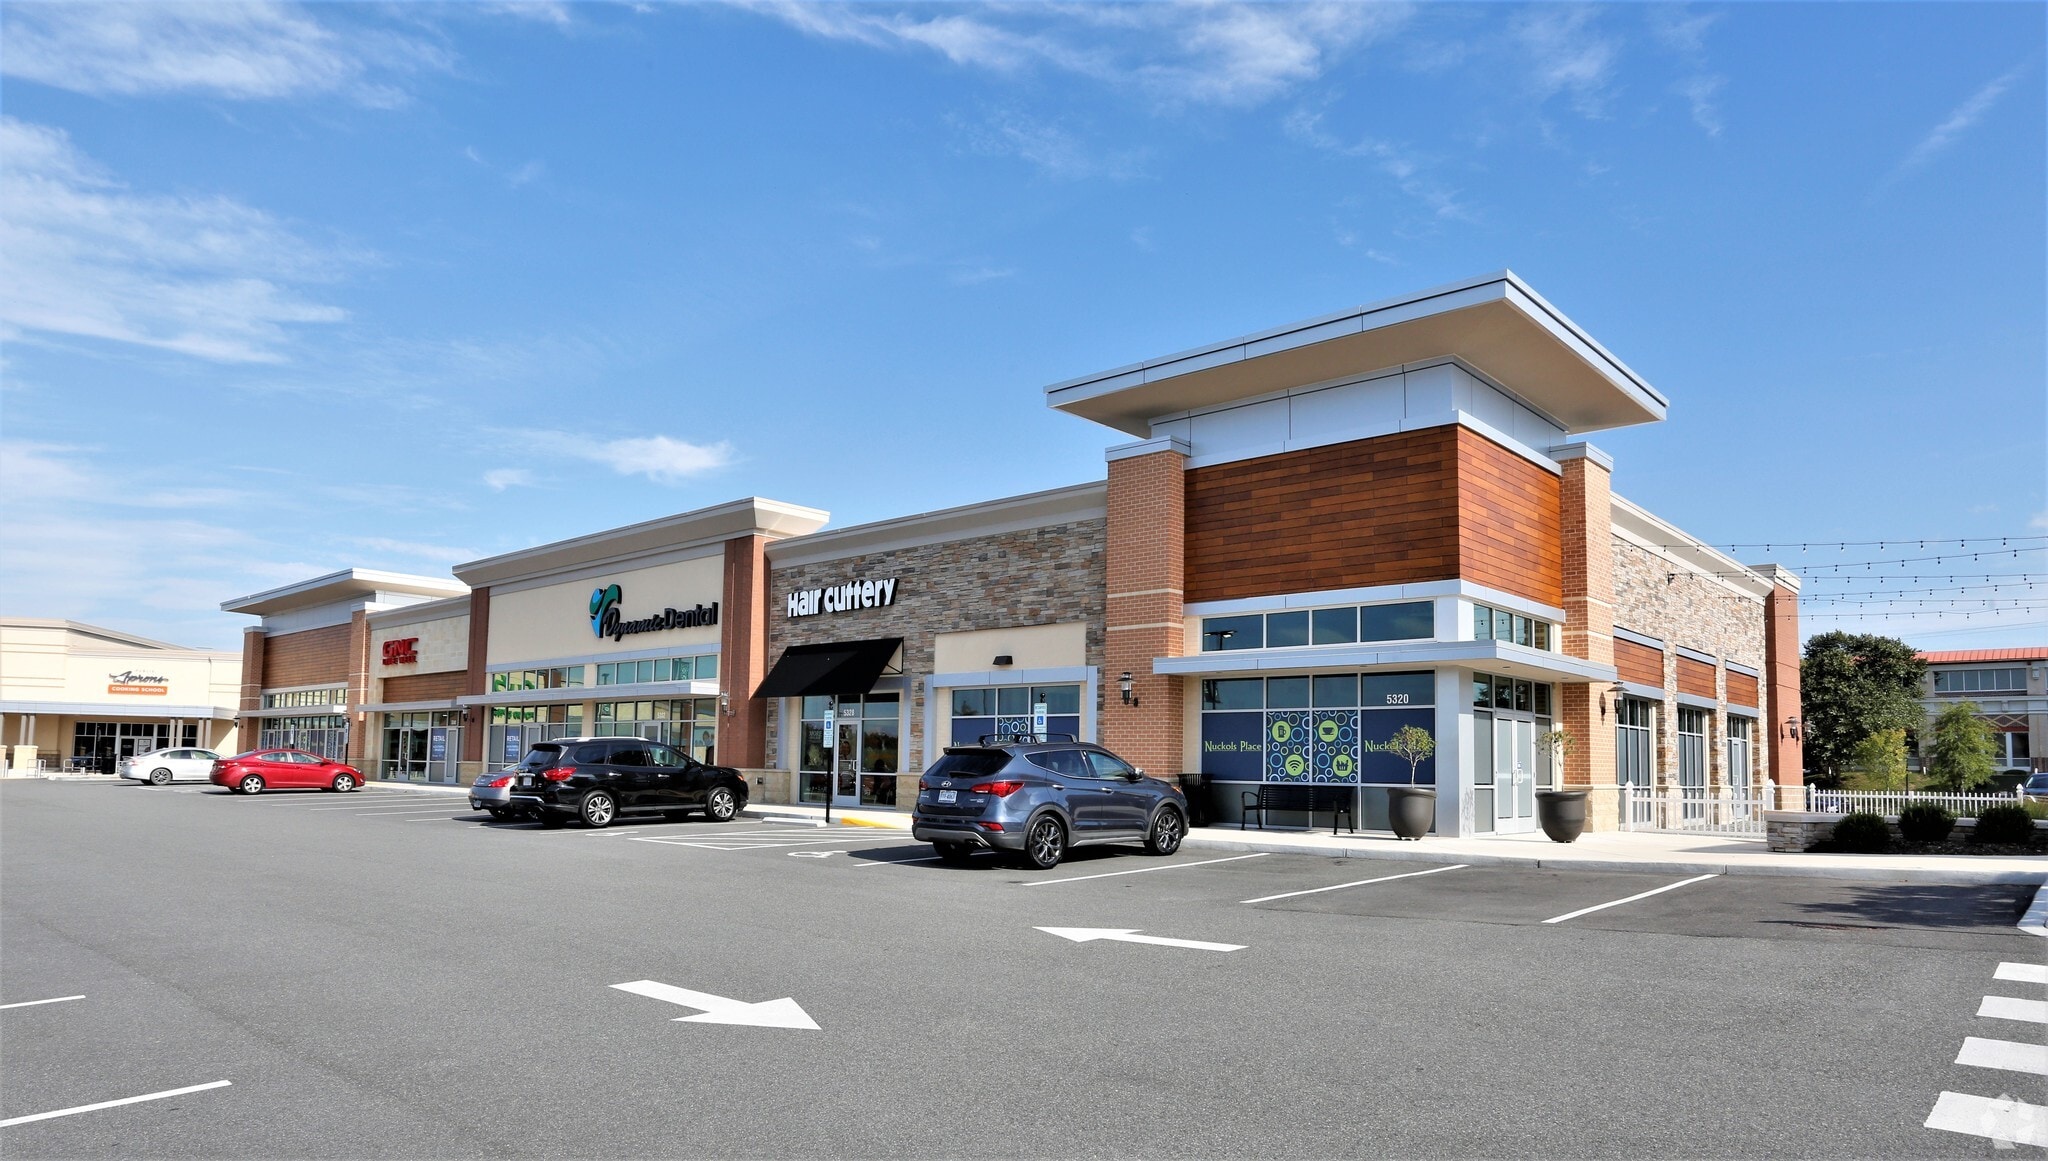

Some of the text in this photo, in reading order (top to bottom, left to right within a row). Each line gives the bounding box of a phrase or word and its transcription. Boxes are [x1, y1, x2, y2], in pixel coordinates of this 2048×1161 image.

[787, 588, 822, 618] Hair
[602, 602, 719, 641] Dynamic Dental
[382, 637, 419, 657] GNC
[109, 670, 169, 684] Aprons
[1386, 693, 1409, 704] 5320
[1204, 740, 1262, 752] Nuckols Place
